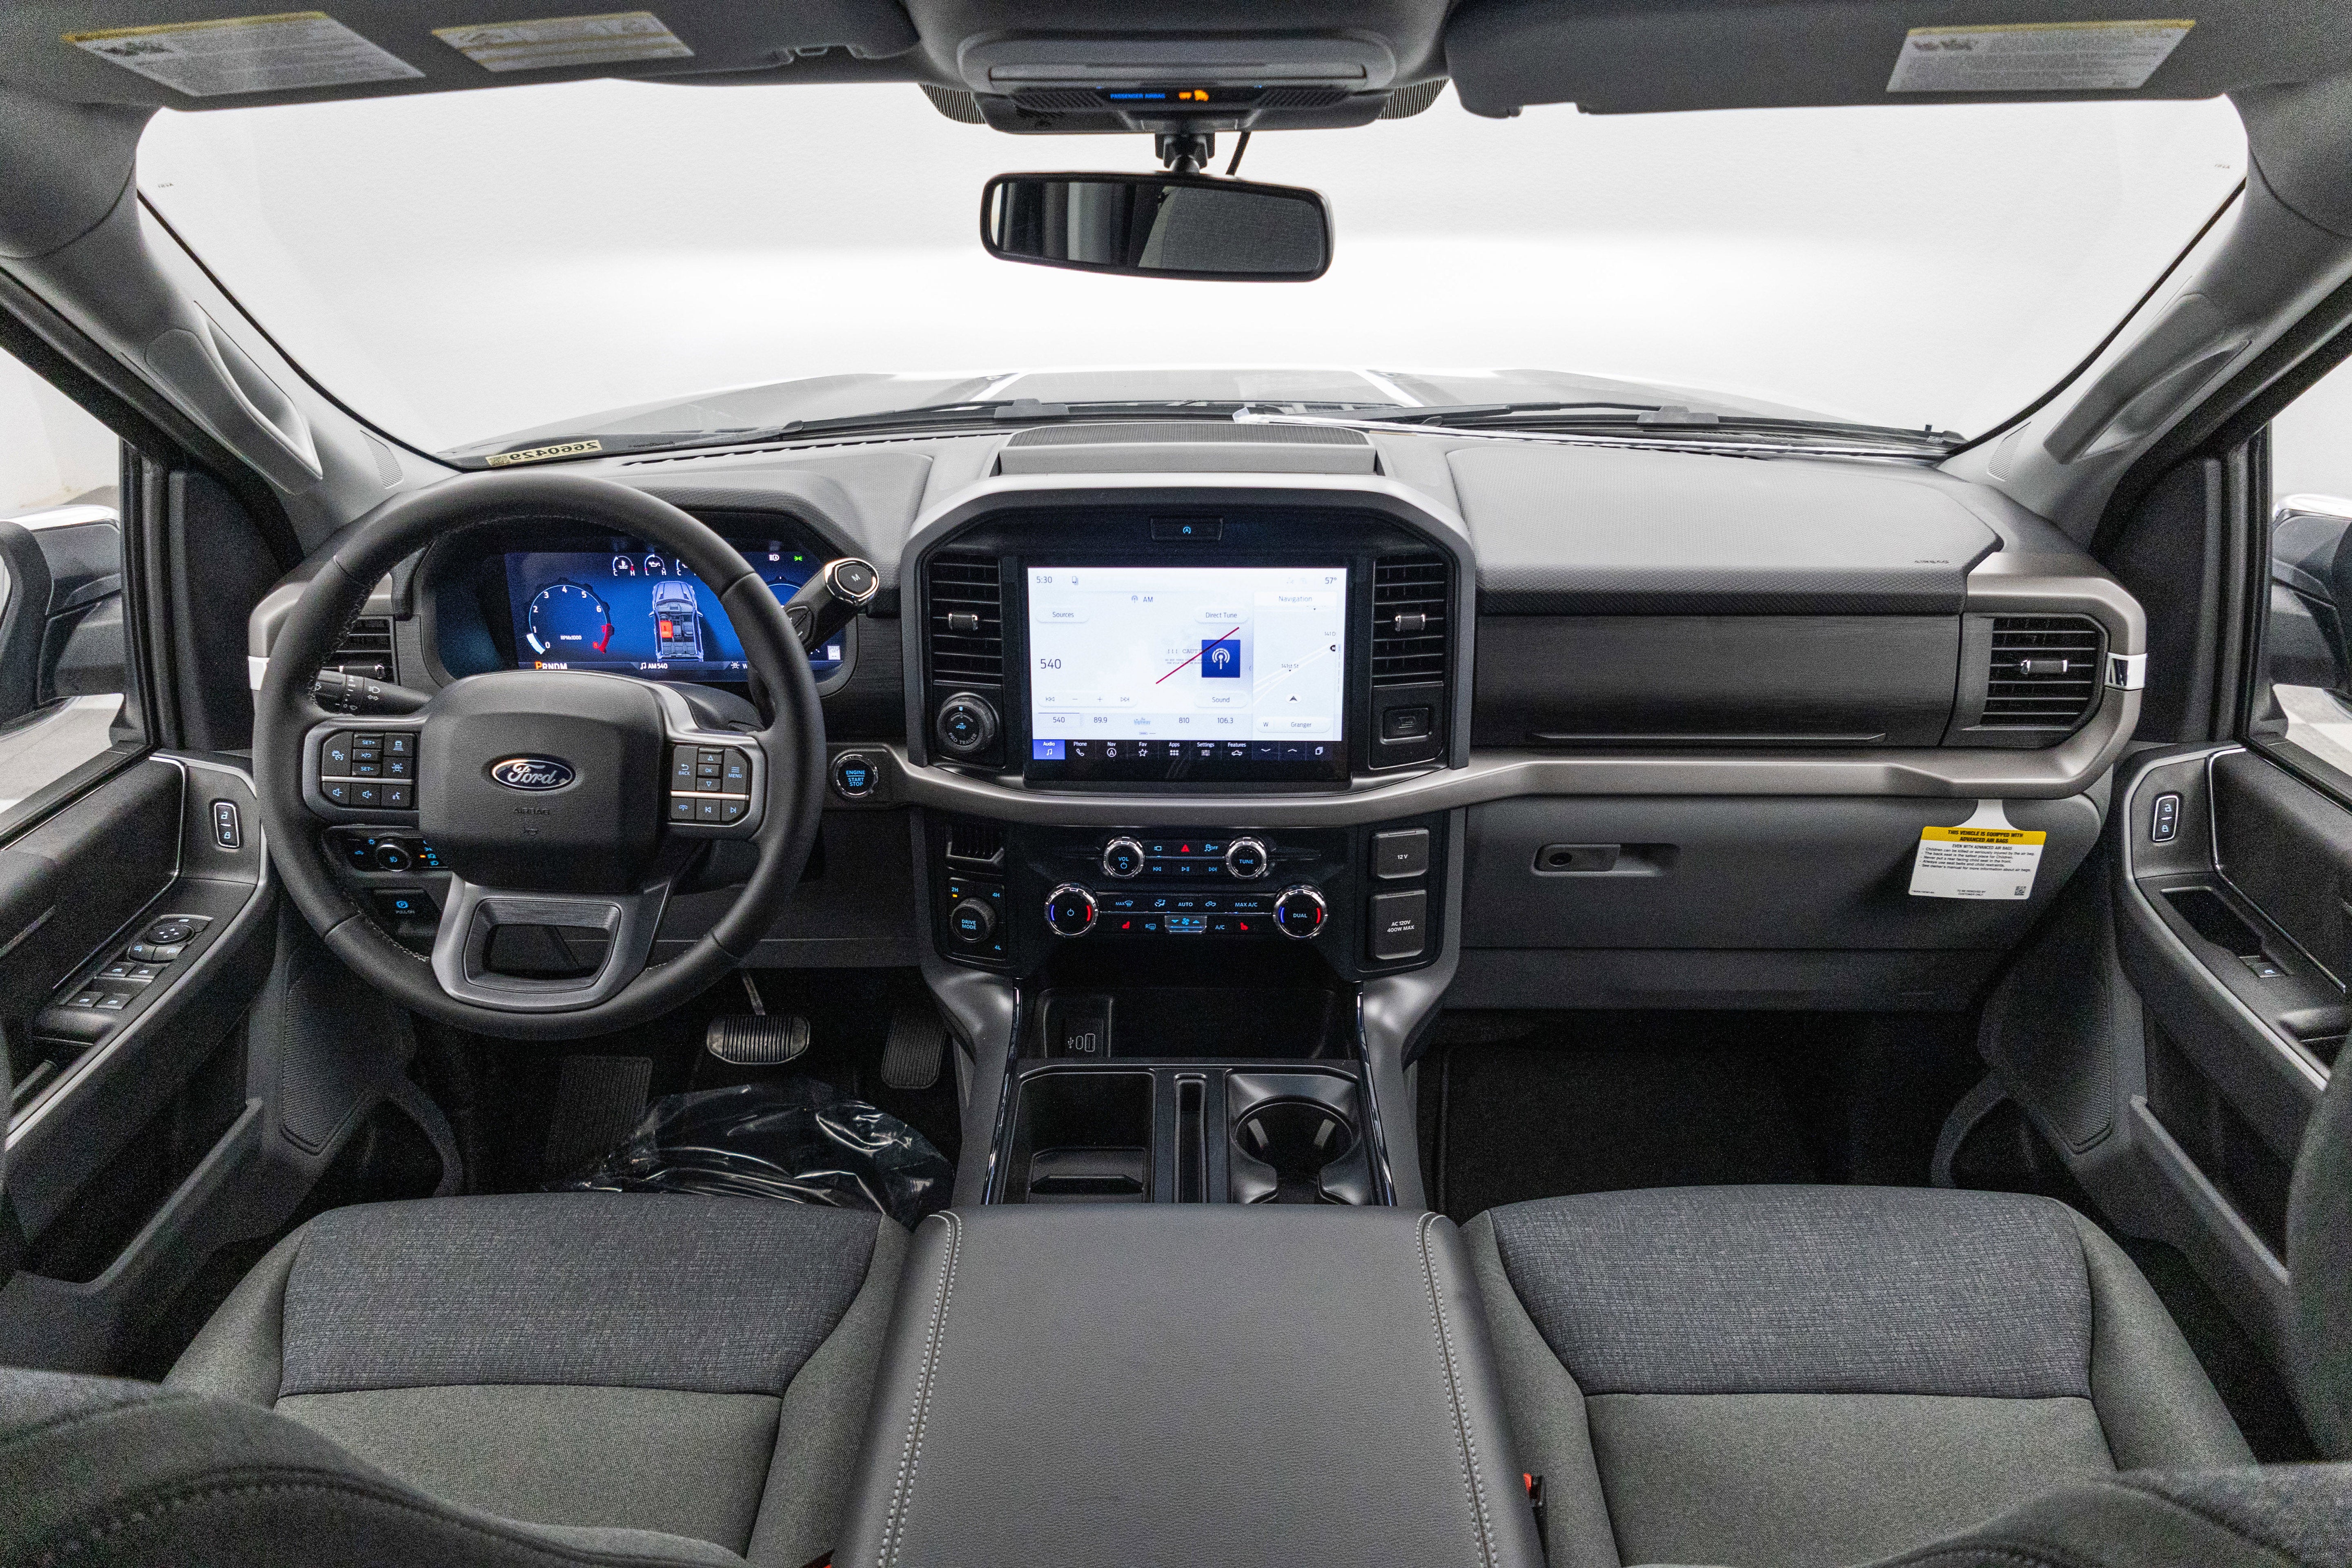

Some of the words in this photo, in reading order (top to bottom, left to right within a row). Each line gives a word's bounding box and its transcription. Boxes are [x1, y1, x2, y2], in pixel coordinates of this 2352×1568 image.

[851, 573, 861, 582] M
[1040, 659, 1062, 669] 540
[948, 732, 958, 743] PRO
[959, 733, 978, 745] TRAILER
[507, 763, 558, 784] Ford
